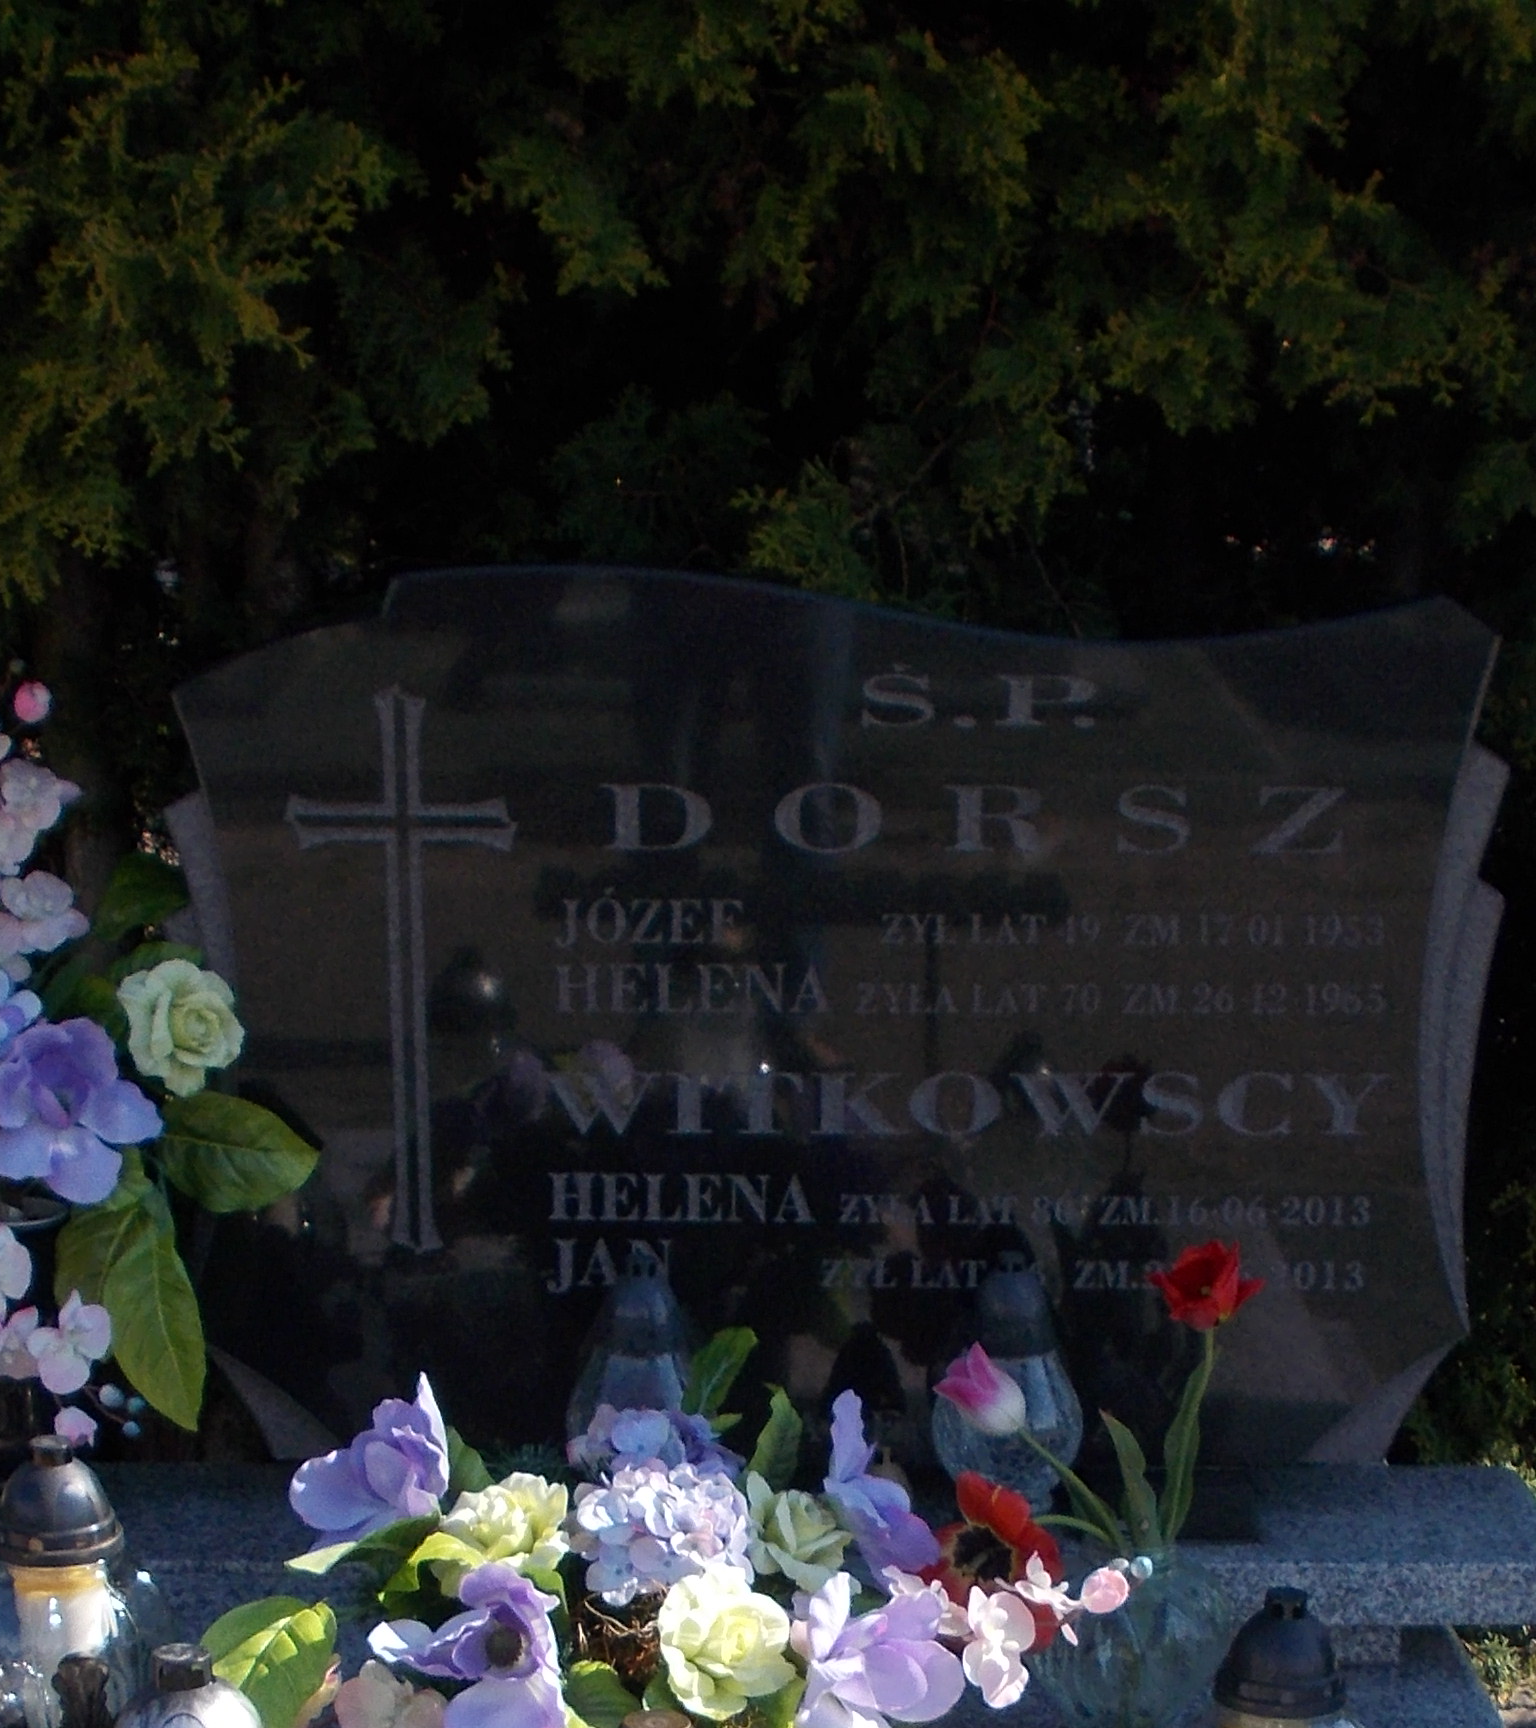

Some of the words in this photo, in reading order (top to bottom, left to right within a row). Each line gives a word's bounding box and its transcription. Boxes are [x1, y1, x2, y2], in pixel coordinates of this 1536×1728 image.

[598, 781, 1348, 858] DORSZ
[555, 886, 745, 950] JÓZEF
[969, 912, 1048, 945] LAT
[555, 962, 832, 1015] HELENA
[971, 982, 1048, 1016] LAT
[546, 1070, 1393, 1138] WITKOWSCY
[546, 1170, 817, 1226] HELENA
[947, 1193, 1019, 1226] LAT
[910, 1257, 988, 1290] LAT
